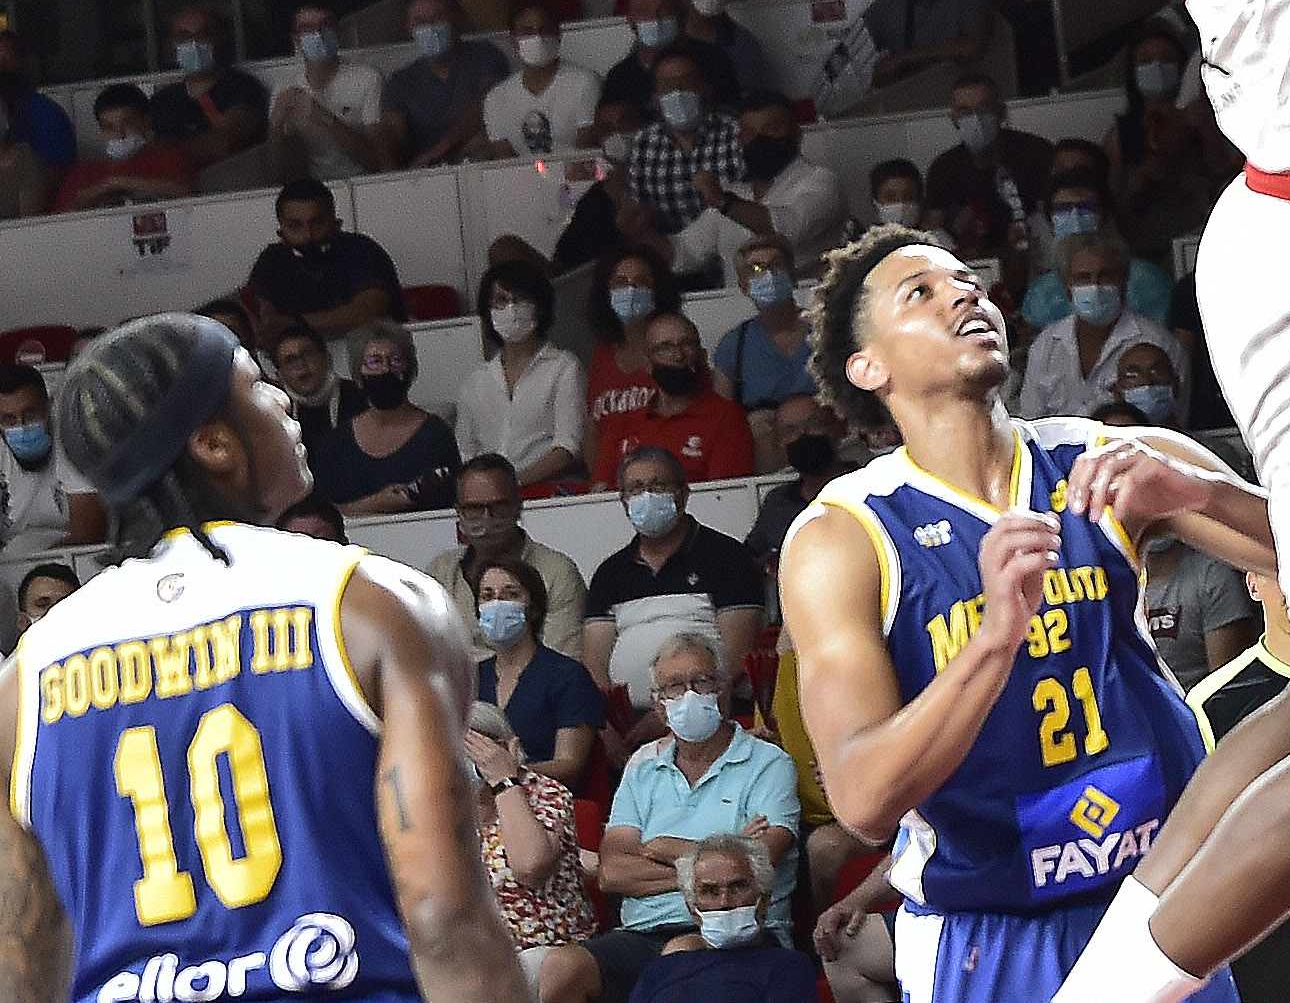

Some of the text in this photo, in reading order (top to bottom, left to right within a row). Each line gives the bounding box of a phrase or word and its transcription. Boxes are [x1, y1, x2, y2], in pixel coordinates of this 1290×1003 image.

[40, 606, 312, 725] GOODWIN III
[1026, 608, 1072, 659] 92
[1032, 667, 1110, 768] 21
[114, 703, 284, 927] 10
[1031, 818, 1160, 888] FAYAT
